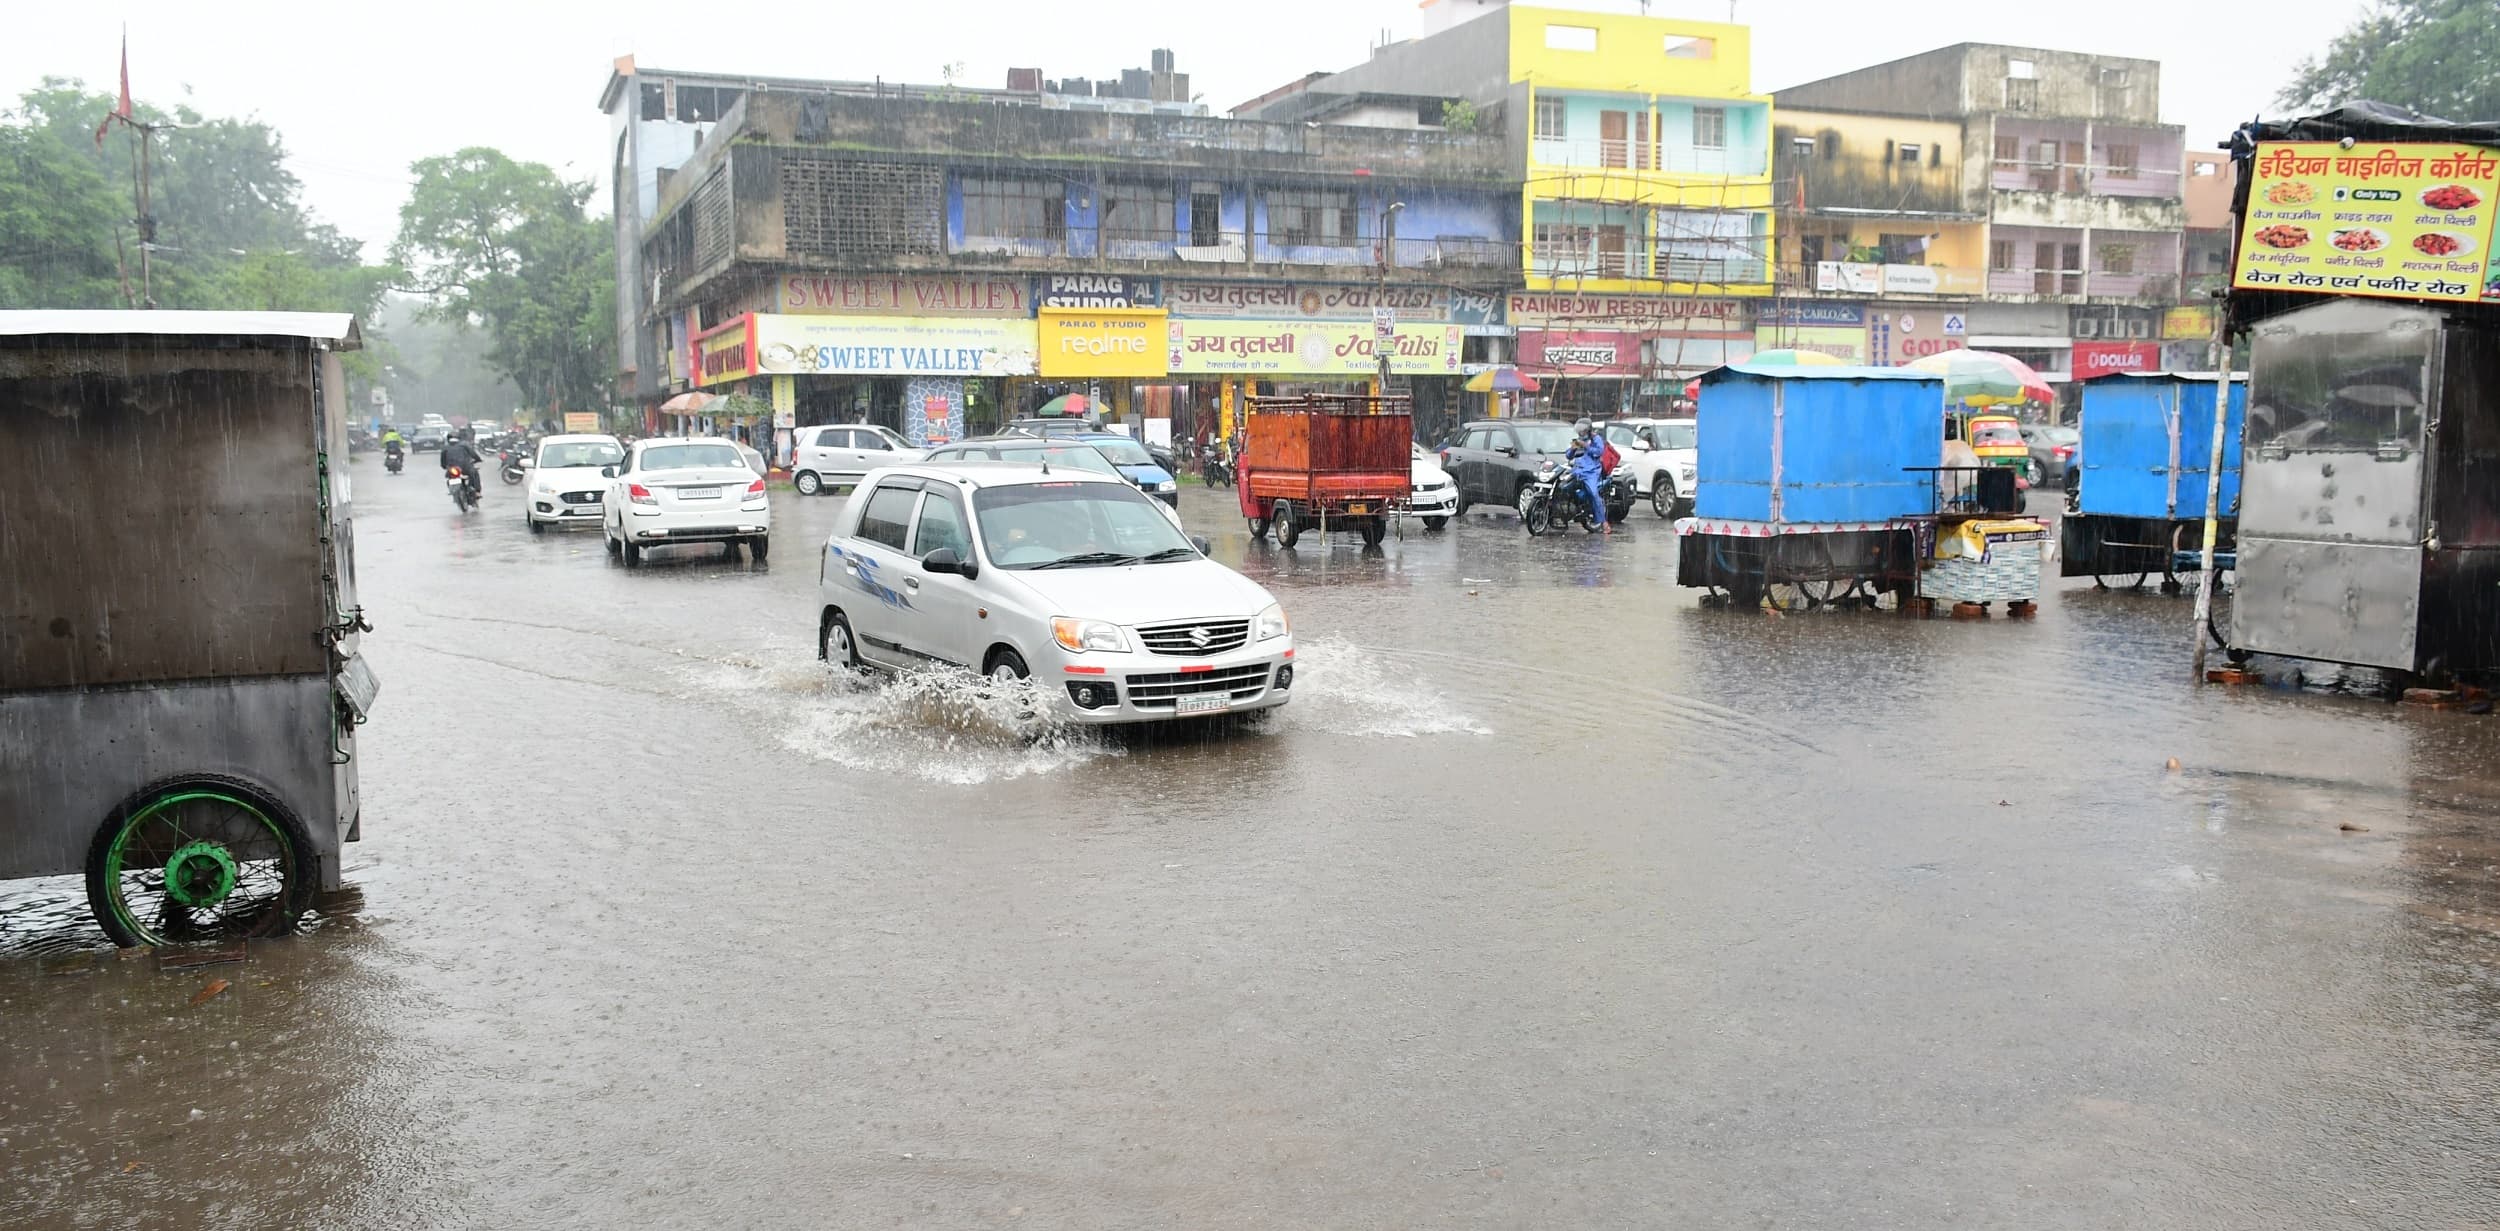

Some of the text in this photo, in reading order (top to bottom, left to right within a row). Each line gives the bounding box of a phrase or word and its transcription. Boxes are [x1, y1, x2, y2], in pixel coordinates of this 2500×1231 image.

[2259, 148, 2498, 180] इंडियन चाइनिज कॉर्नर
[2355, 190, 2399, 201] Only Veg
[2253, 209, 2321, 221] वेज चाउमीन
[2366, 213, 2393, 223] राइस
[2415, 214, 2476, 226] सोया चिल्ली
[2248, 252, 2265, 262] वेज
[2325, 256, 2384, 268] पनीर चिल्ली
[2447, 260, 2480, 273] चिल्ली
[1051, 275, 1124, 294] PARAG
[2246, 269, 2469, 296] वेज रोल एवं पनीर रोल
[788, 277, 1024, 311] SWEET VALLEY
[1047, 296, 1128, 309] STUDIO
[1178, 283, 1297, 310] जय तुलसी
[1325, 286, 1369, 308] Jai
[1511, 296, 1737, 316] RAINBOW RESTAURANT
[1059, 320, 1146, 329] PARAG STUDIO
[1061, 333, 1147, 356] realme
[1187, 333, 1295, 359] जय तुलसी
[1335, 335, 1375, 357] Ja
[1902, 339, 1963, 356] GOLD
[818, 346, 984, 371] SWEET VALLEY
[1345, 360, 1377, 369] Textiles
[1406, 361, 1430, 369] Room
[2100, 353, 2142, 367] DOLLAR
